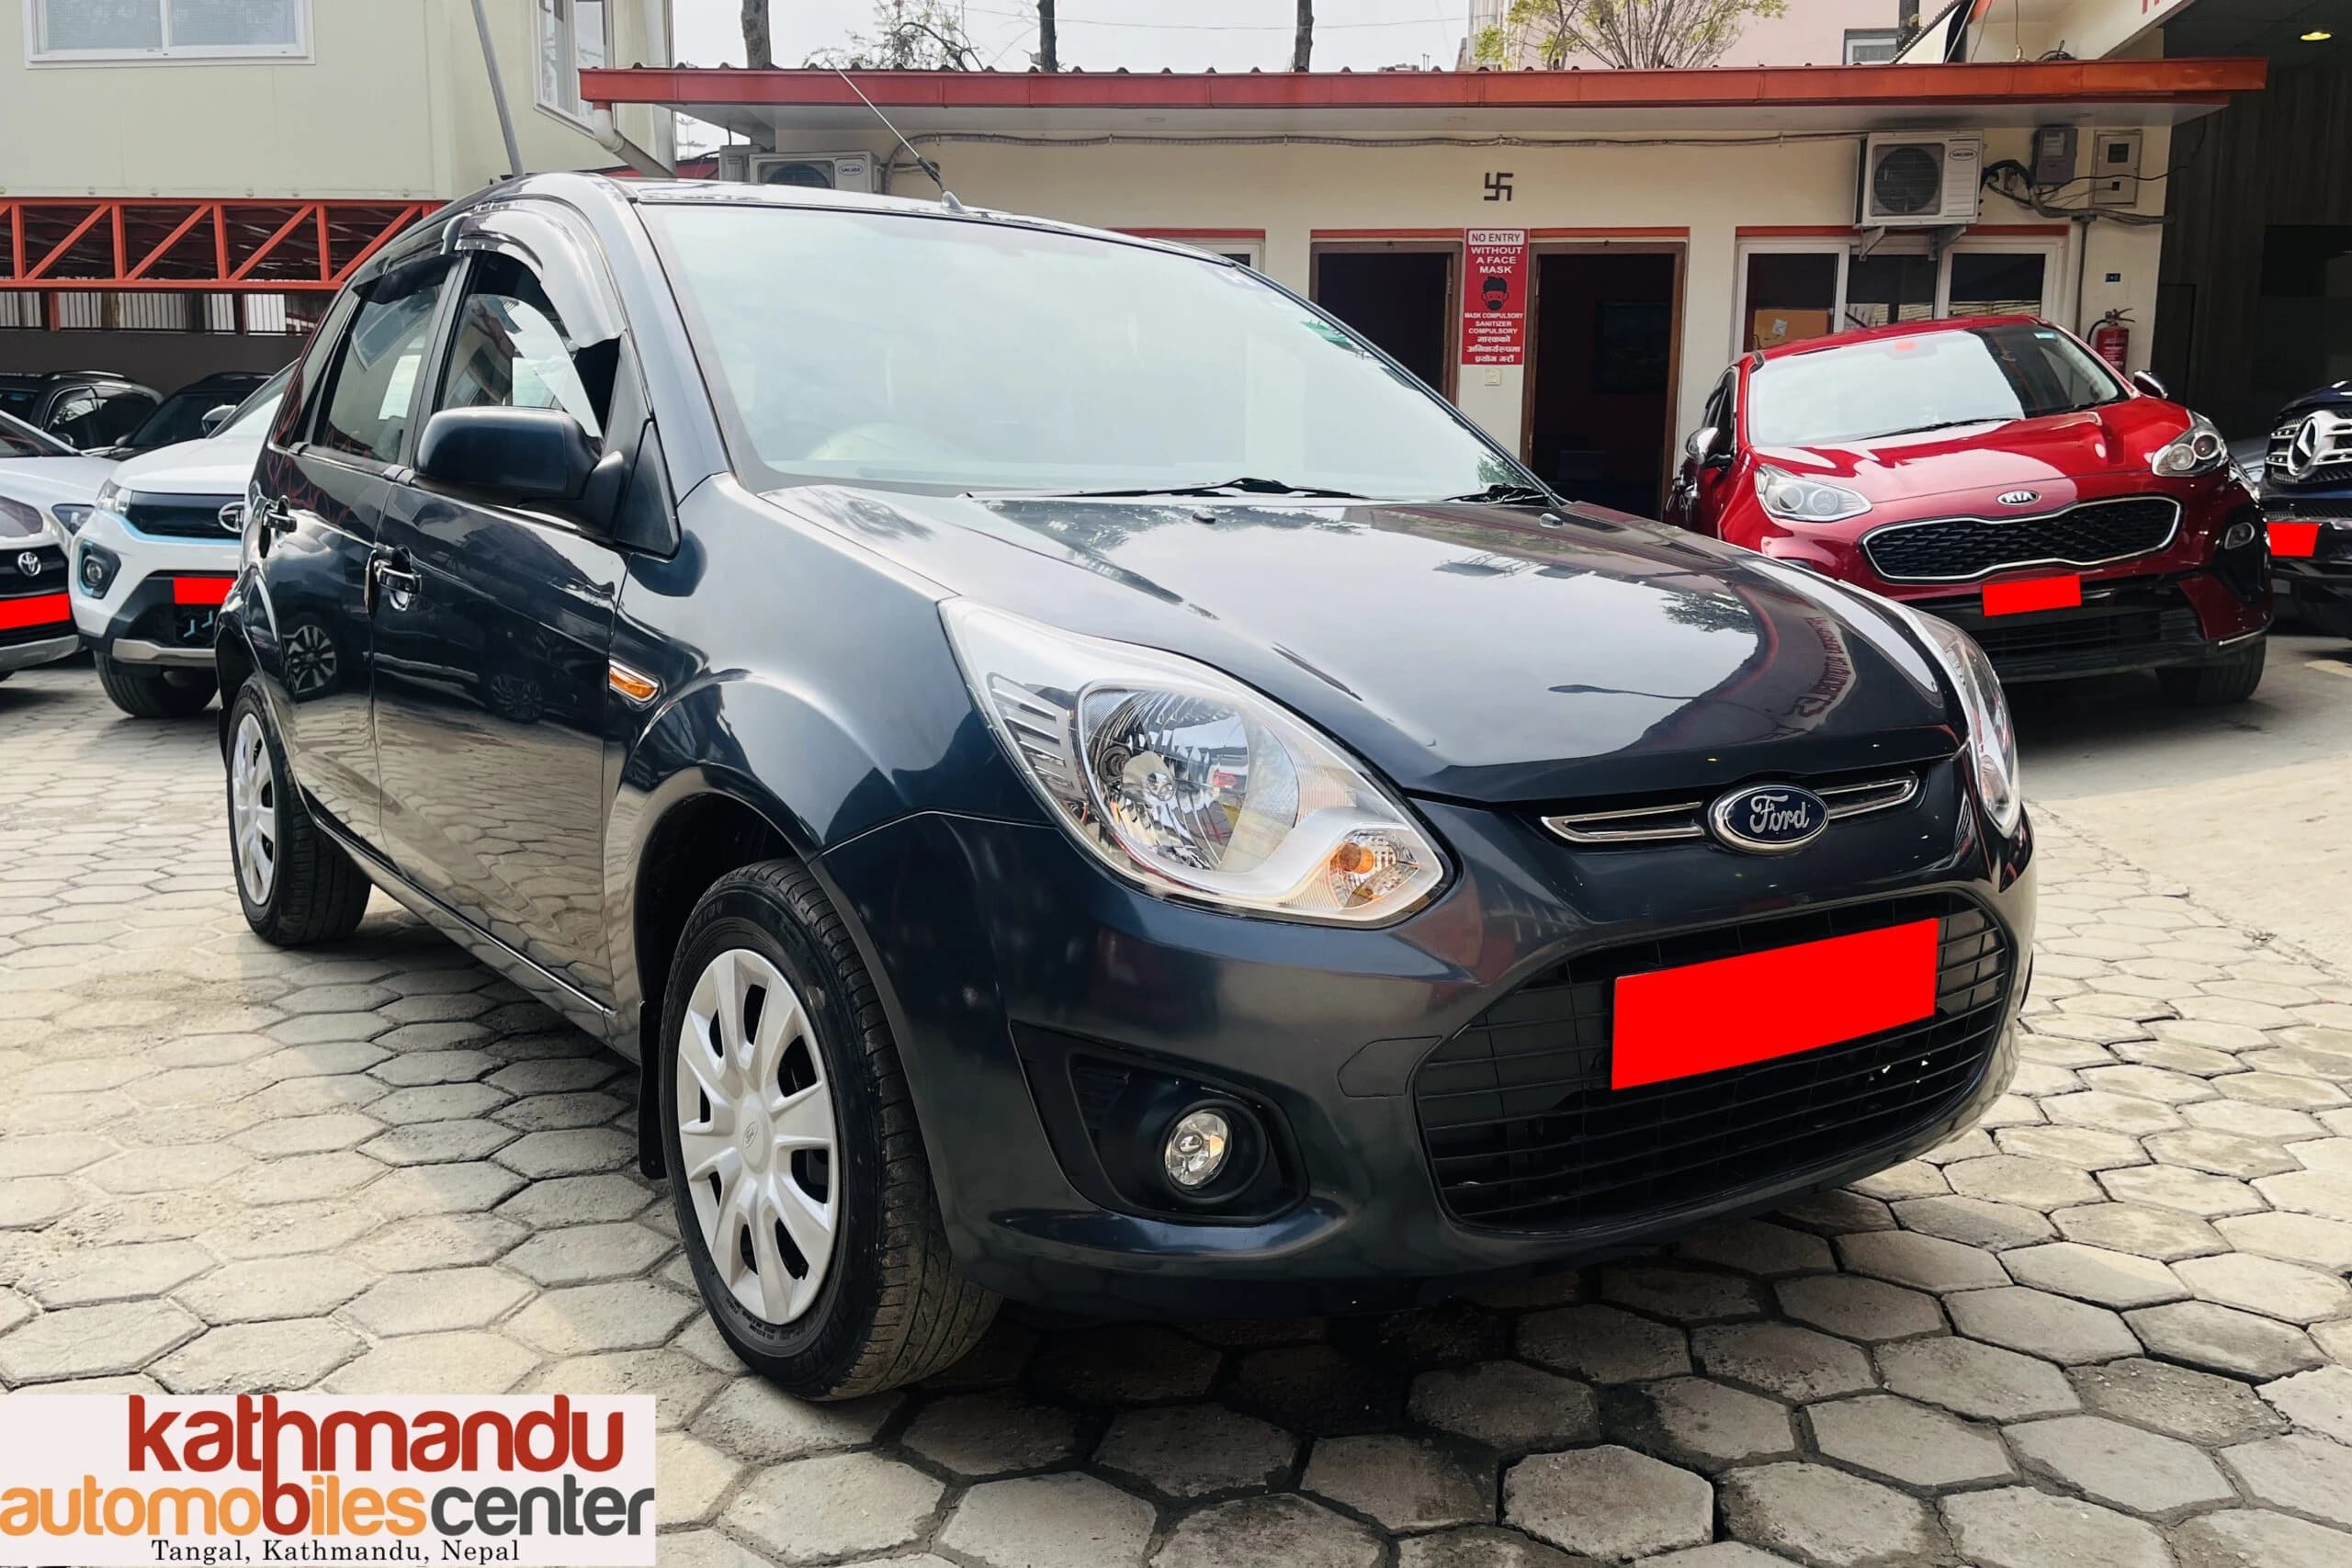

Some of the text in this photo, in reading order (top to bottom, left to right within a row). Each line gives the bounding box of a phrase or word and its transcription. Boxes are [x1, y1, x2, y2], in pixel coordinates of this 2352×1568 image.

[1472, 233, 1521, 242] NO ENTRY
[1470, 246, 1522, 254] WITHOUT
[1476, 256, 1517, 265] A FACE
[1479, 265, 1512, 274] MASK
[2006, 491, 2034, 503] KIA
[1749, 795, 1810, 833] Ford
